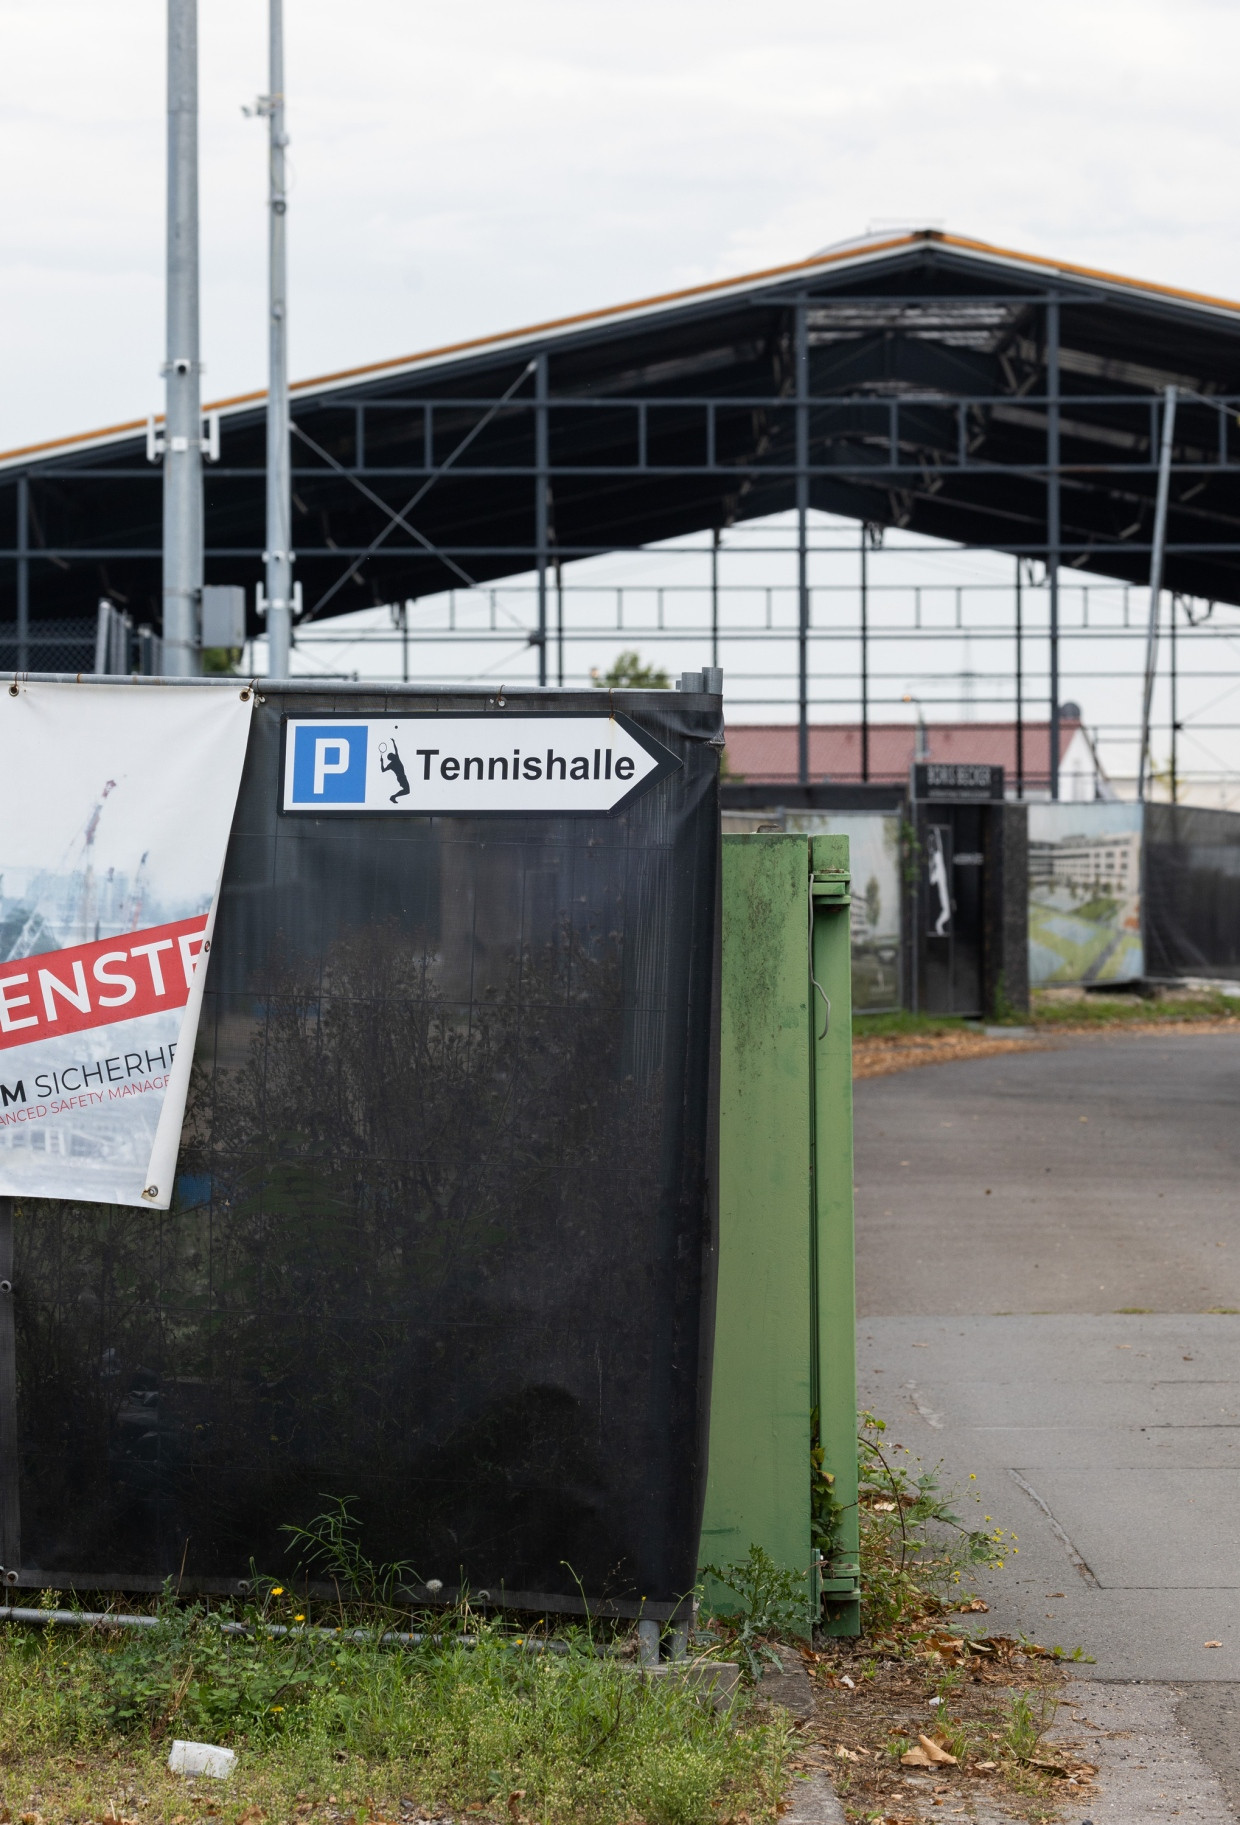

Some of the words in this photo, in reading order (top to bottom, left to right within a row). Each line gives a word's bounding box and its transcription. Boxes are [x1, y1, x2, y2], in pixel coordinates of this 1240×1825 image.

[313, 737, 350, 794] P
[416, 748, 636, 781] Tennishalle
[0, 1080, 27, 1107] M
[50, 1090, 105, 1114] SAFETY
